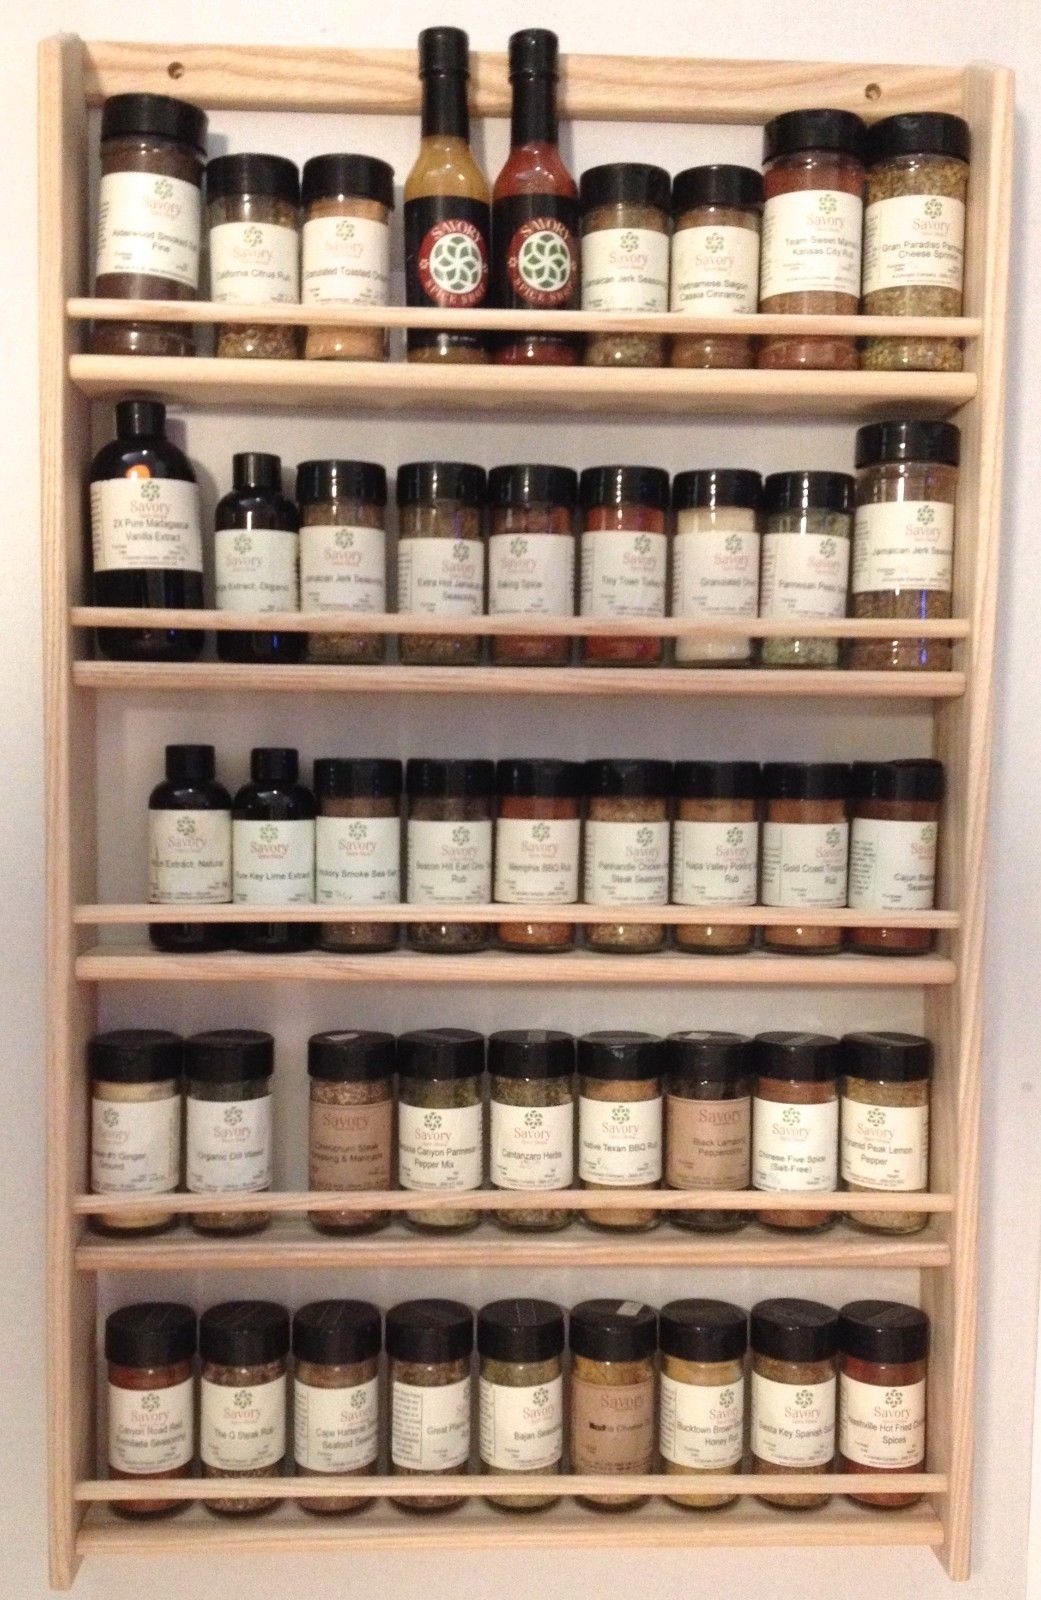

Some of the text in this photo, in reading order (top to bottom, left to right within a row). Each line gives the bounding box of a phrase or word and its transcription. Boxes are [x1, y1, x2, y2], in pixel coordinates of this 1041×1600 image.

[430, 220, 480, 242] SAVORY
[518, 218, 570, 239] SAVORY
[912, 218, 950, 232] Savory
[608, 253, 648, 267] Savory
[695, 253, 735, 267] Savory
[898, 250, 931, 259] Cheese
[130, 500, 170, 515] Savory
[126, 532, 152, 542] Vanilla
[250, 842, 288, 856] Savory
[338, 839, 376, 853] Savory
[266, 872, 286, 882] Lime
[341, 871, 370, 880] Smoke
[698, 1108, 742, 1125] Savory
[414, 1128, 453, 1143] Savory
[514, 1127, 551, 1141] Savory
[602, 1123, 639, 1137] Savory
[772, 1124, 810, 1139] Savory
[857, 1124, 895, 1139] Savory
[417, 1147, 444, 1158] Canyon
[603, 1143, 627, 1152] Texan
[628, 1143, 646, 1153] BBQ
[414, 1159, 439, 1170] Pepper
[787, 1154, 804, 1163] Five
[860, 1153, 888, 1167] Pepper
[224, 1408, 261, 1421] Savory
[784, 1406, 821, 1421] Savory
[873, 1406, 911, 1422] Savory
[427, 1424, 448, 1435] Great
[514, 1429, 536, 1441] Bajan
[779, 1427, 793, 1438] Key
[880, 1425, 894, 1433] Hot
[705, 1437, 726, 1447] Honey
